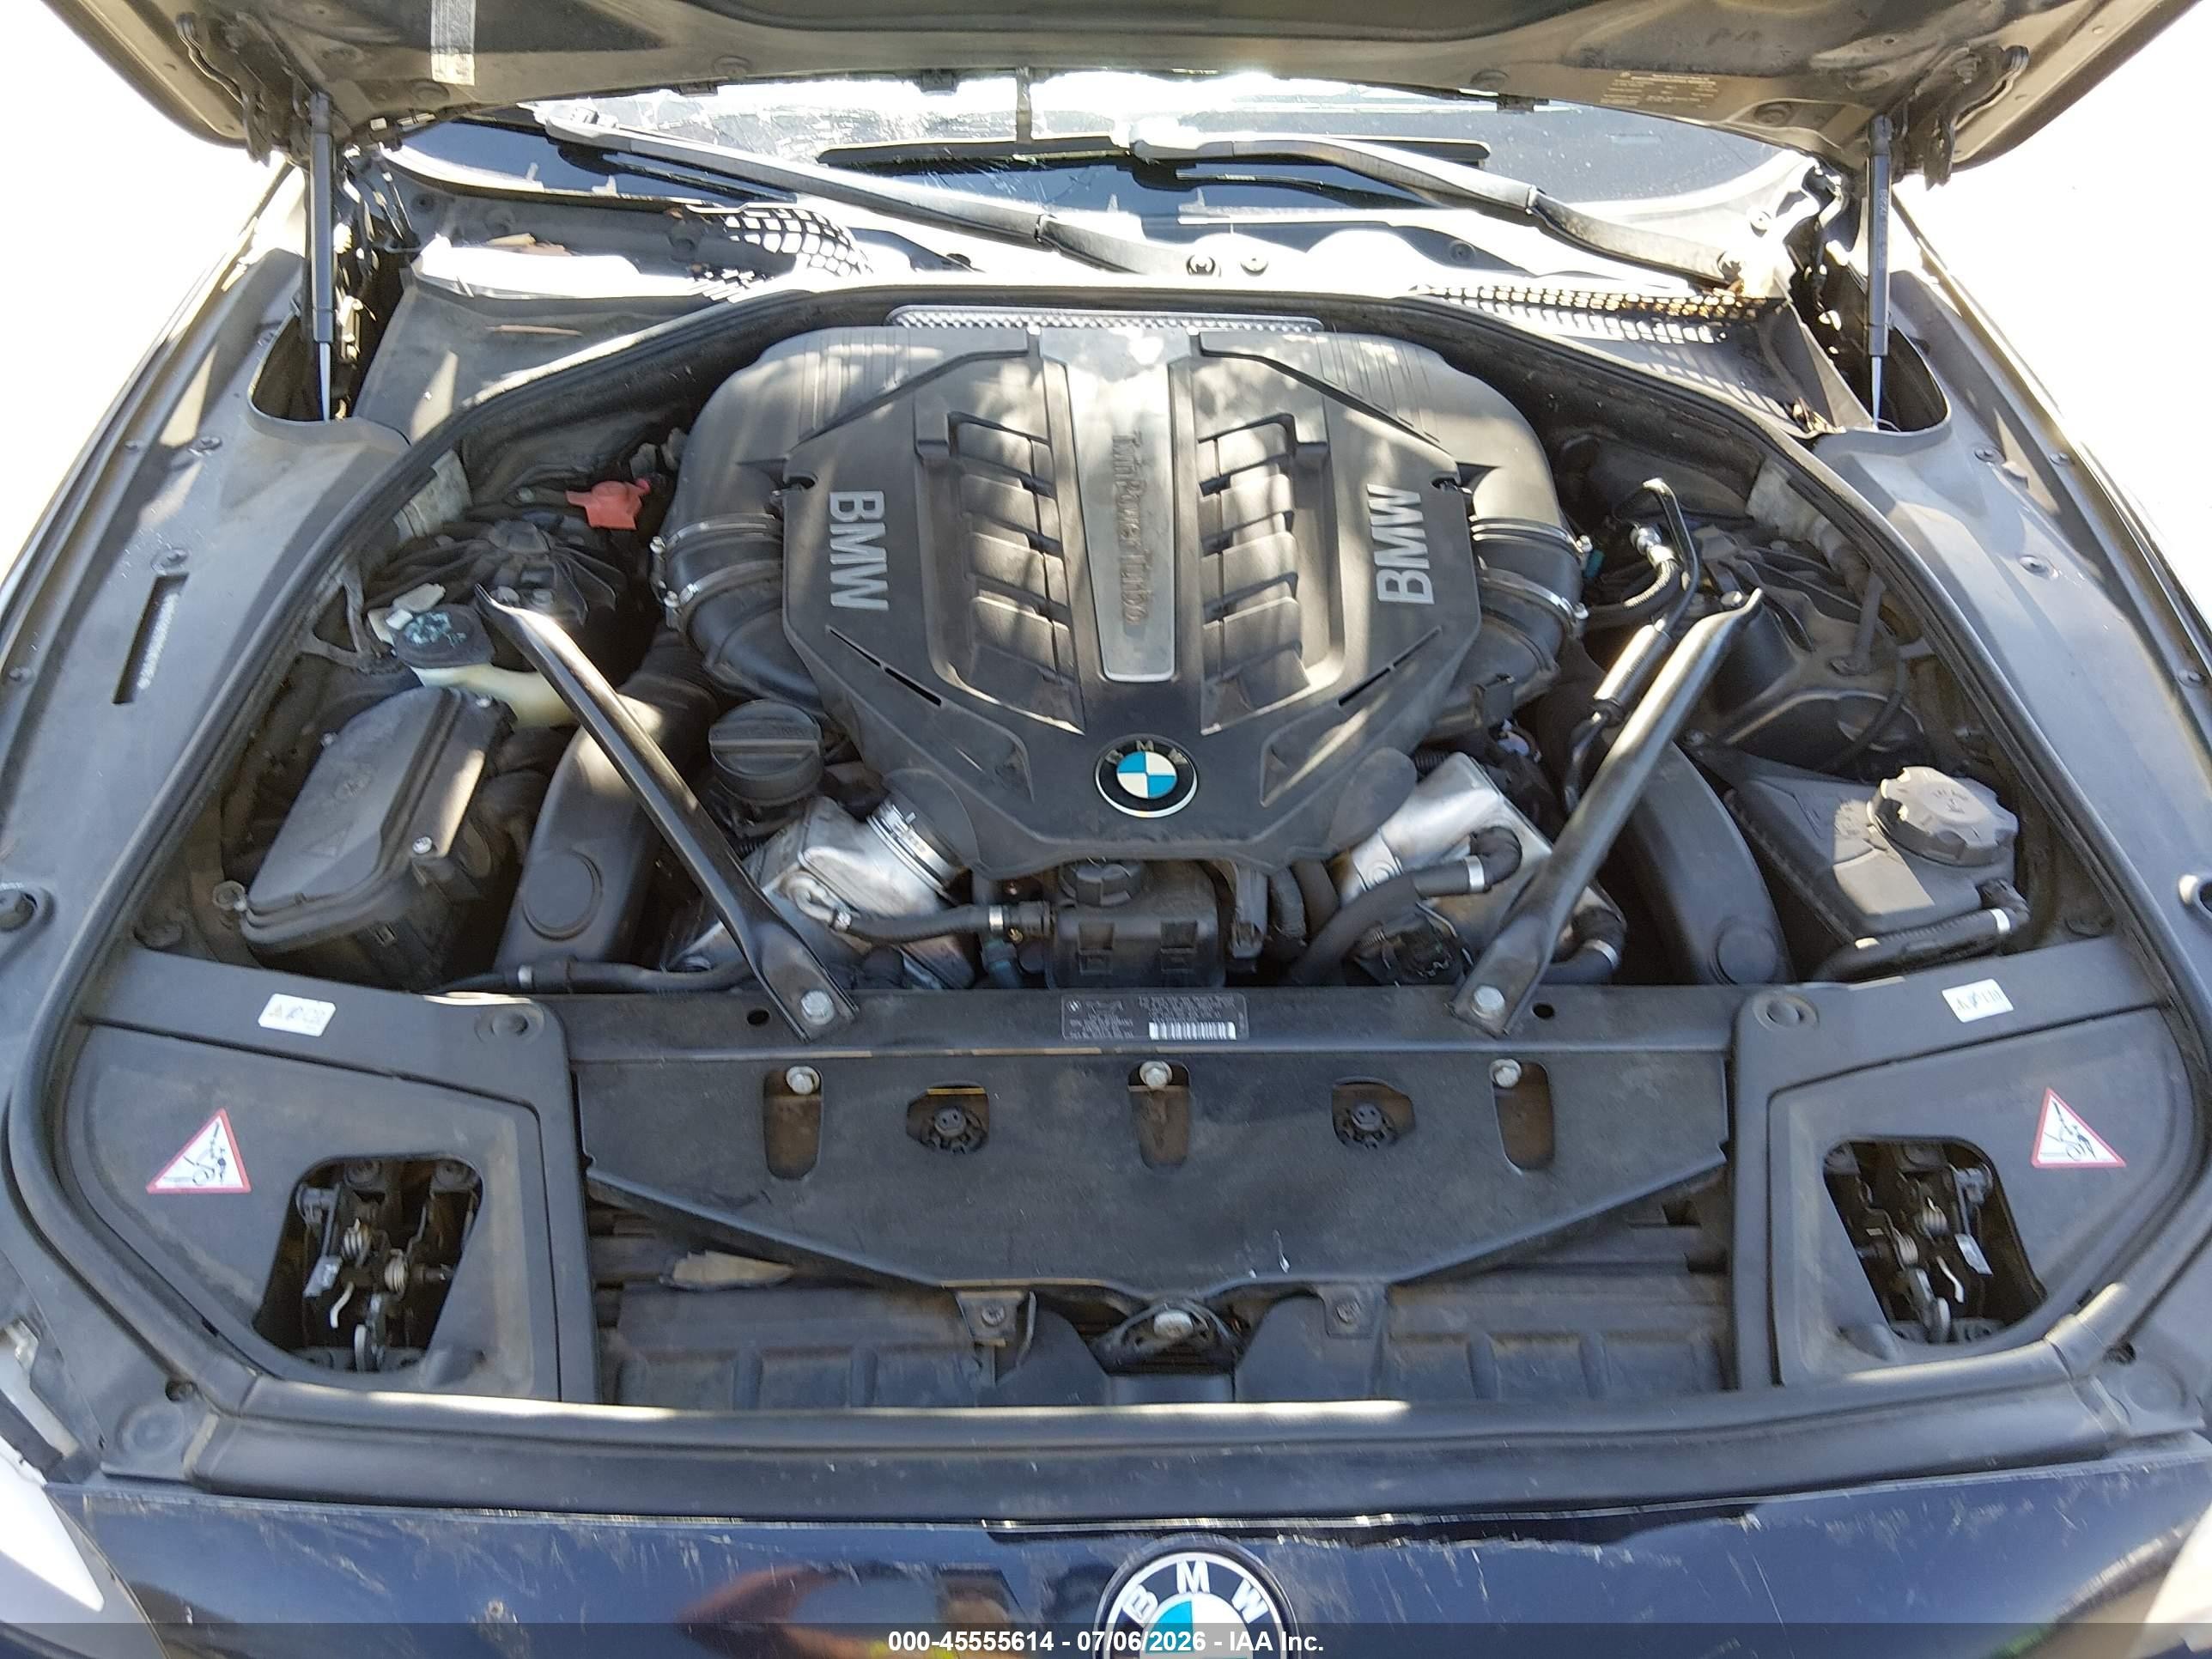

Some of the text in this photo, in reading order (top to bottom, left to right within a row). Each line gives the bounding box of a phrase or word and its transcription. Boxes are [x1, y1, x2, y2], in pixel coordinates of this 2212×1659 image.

[830, 490, 888, 611] BMW
[1367, 484, 1433, 605] BMW
[1105, 739, 1188, 764] BMW
[1121, 1559, 1269, 1628] BMW
